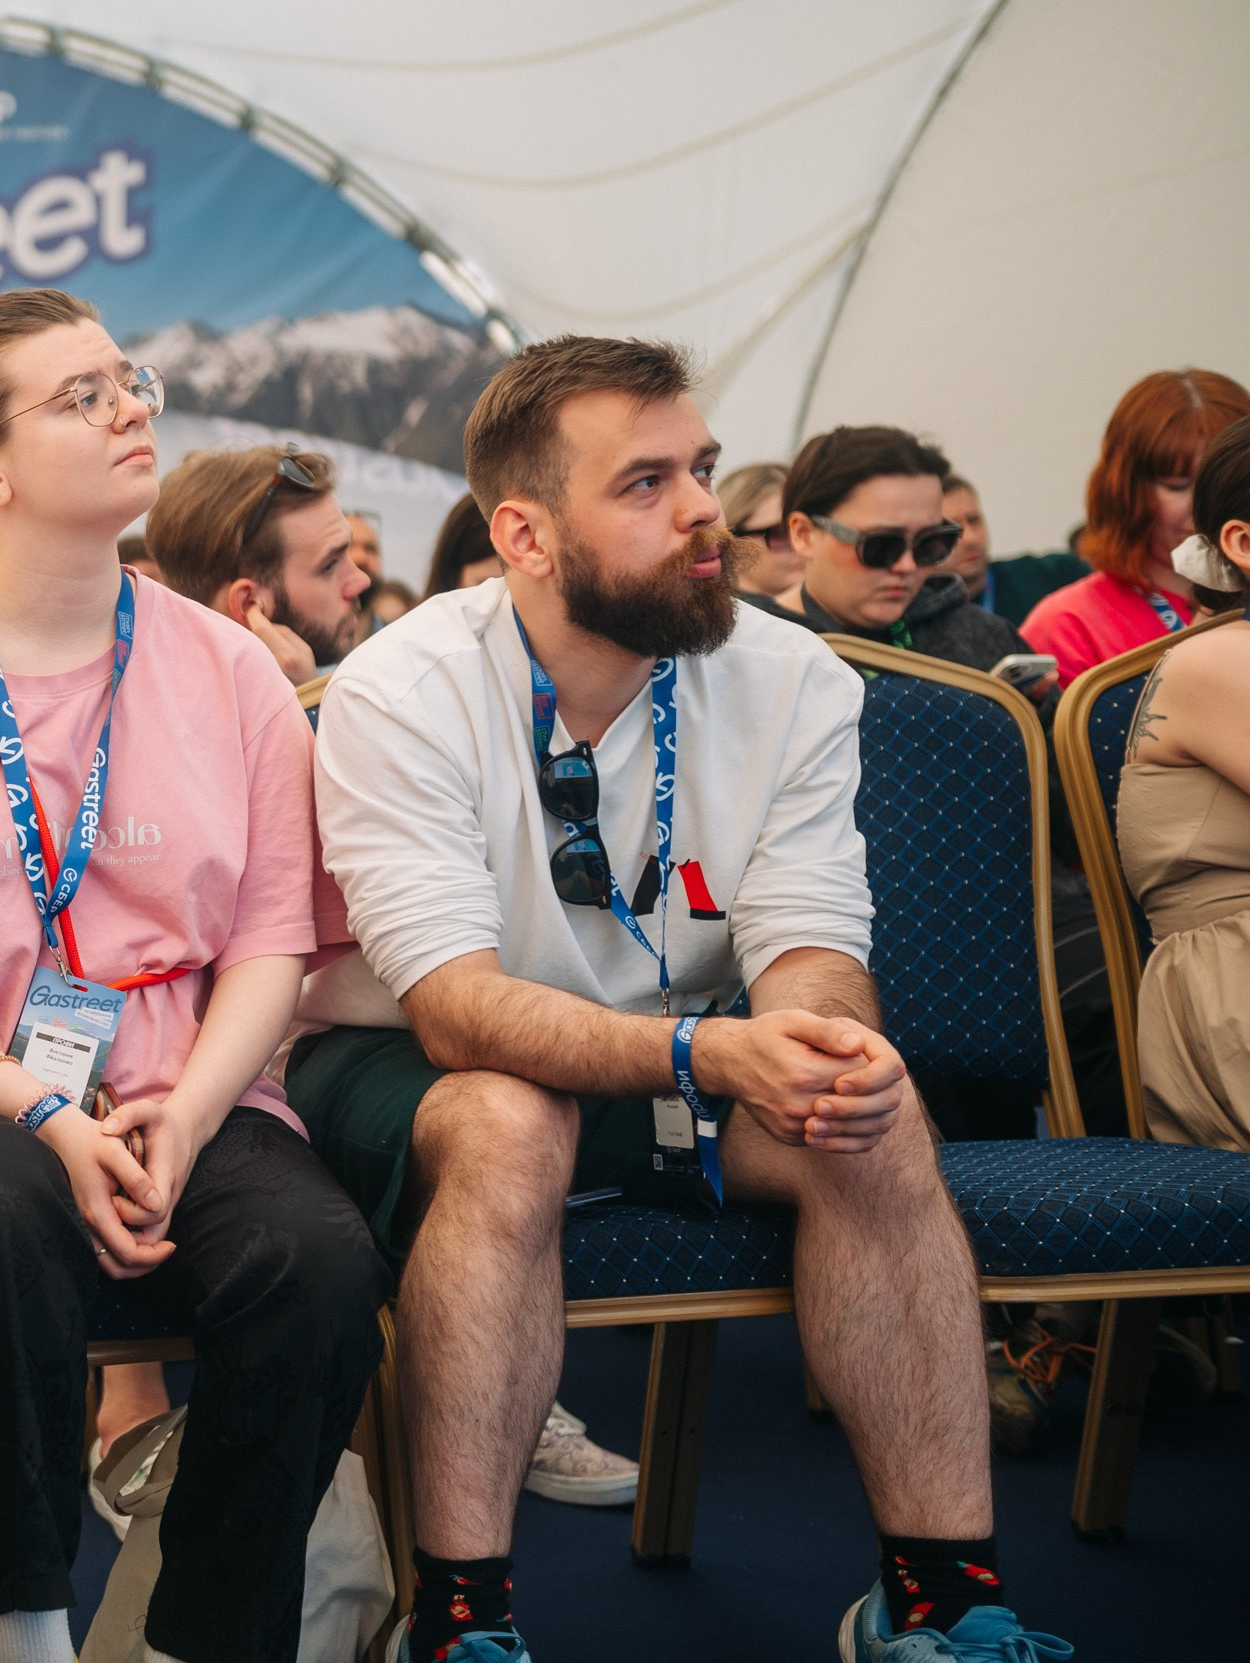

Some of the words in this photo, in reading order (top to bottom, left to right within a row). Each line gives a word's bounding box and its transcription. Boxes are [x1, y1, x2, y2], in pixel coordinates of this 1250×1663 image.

[106, 855, 125, 868] they
[128, 853, 162, 866] appear
[50, 883, 71, 913] СБЕР
[29, 985, 123, 1013] Gastreet
[677, 1070, 710, 1118] профи
[26, 1094, 57, 1131] astreet
